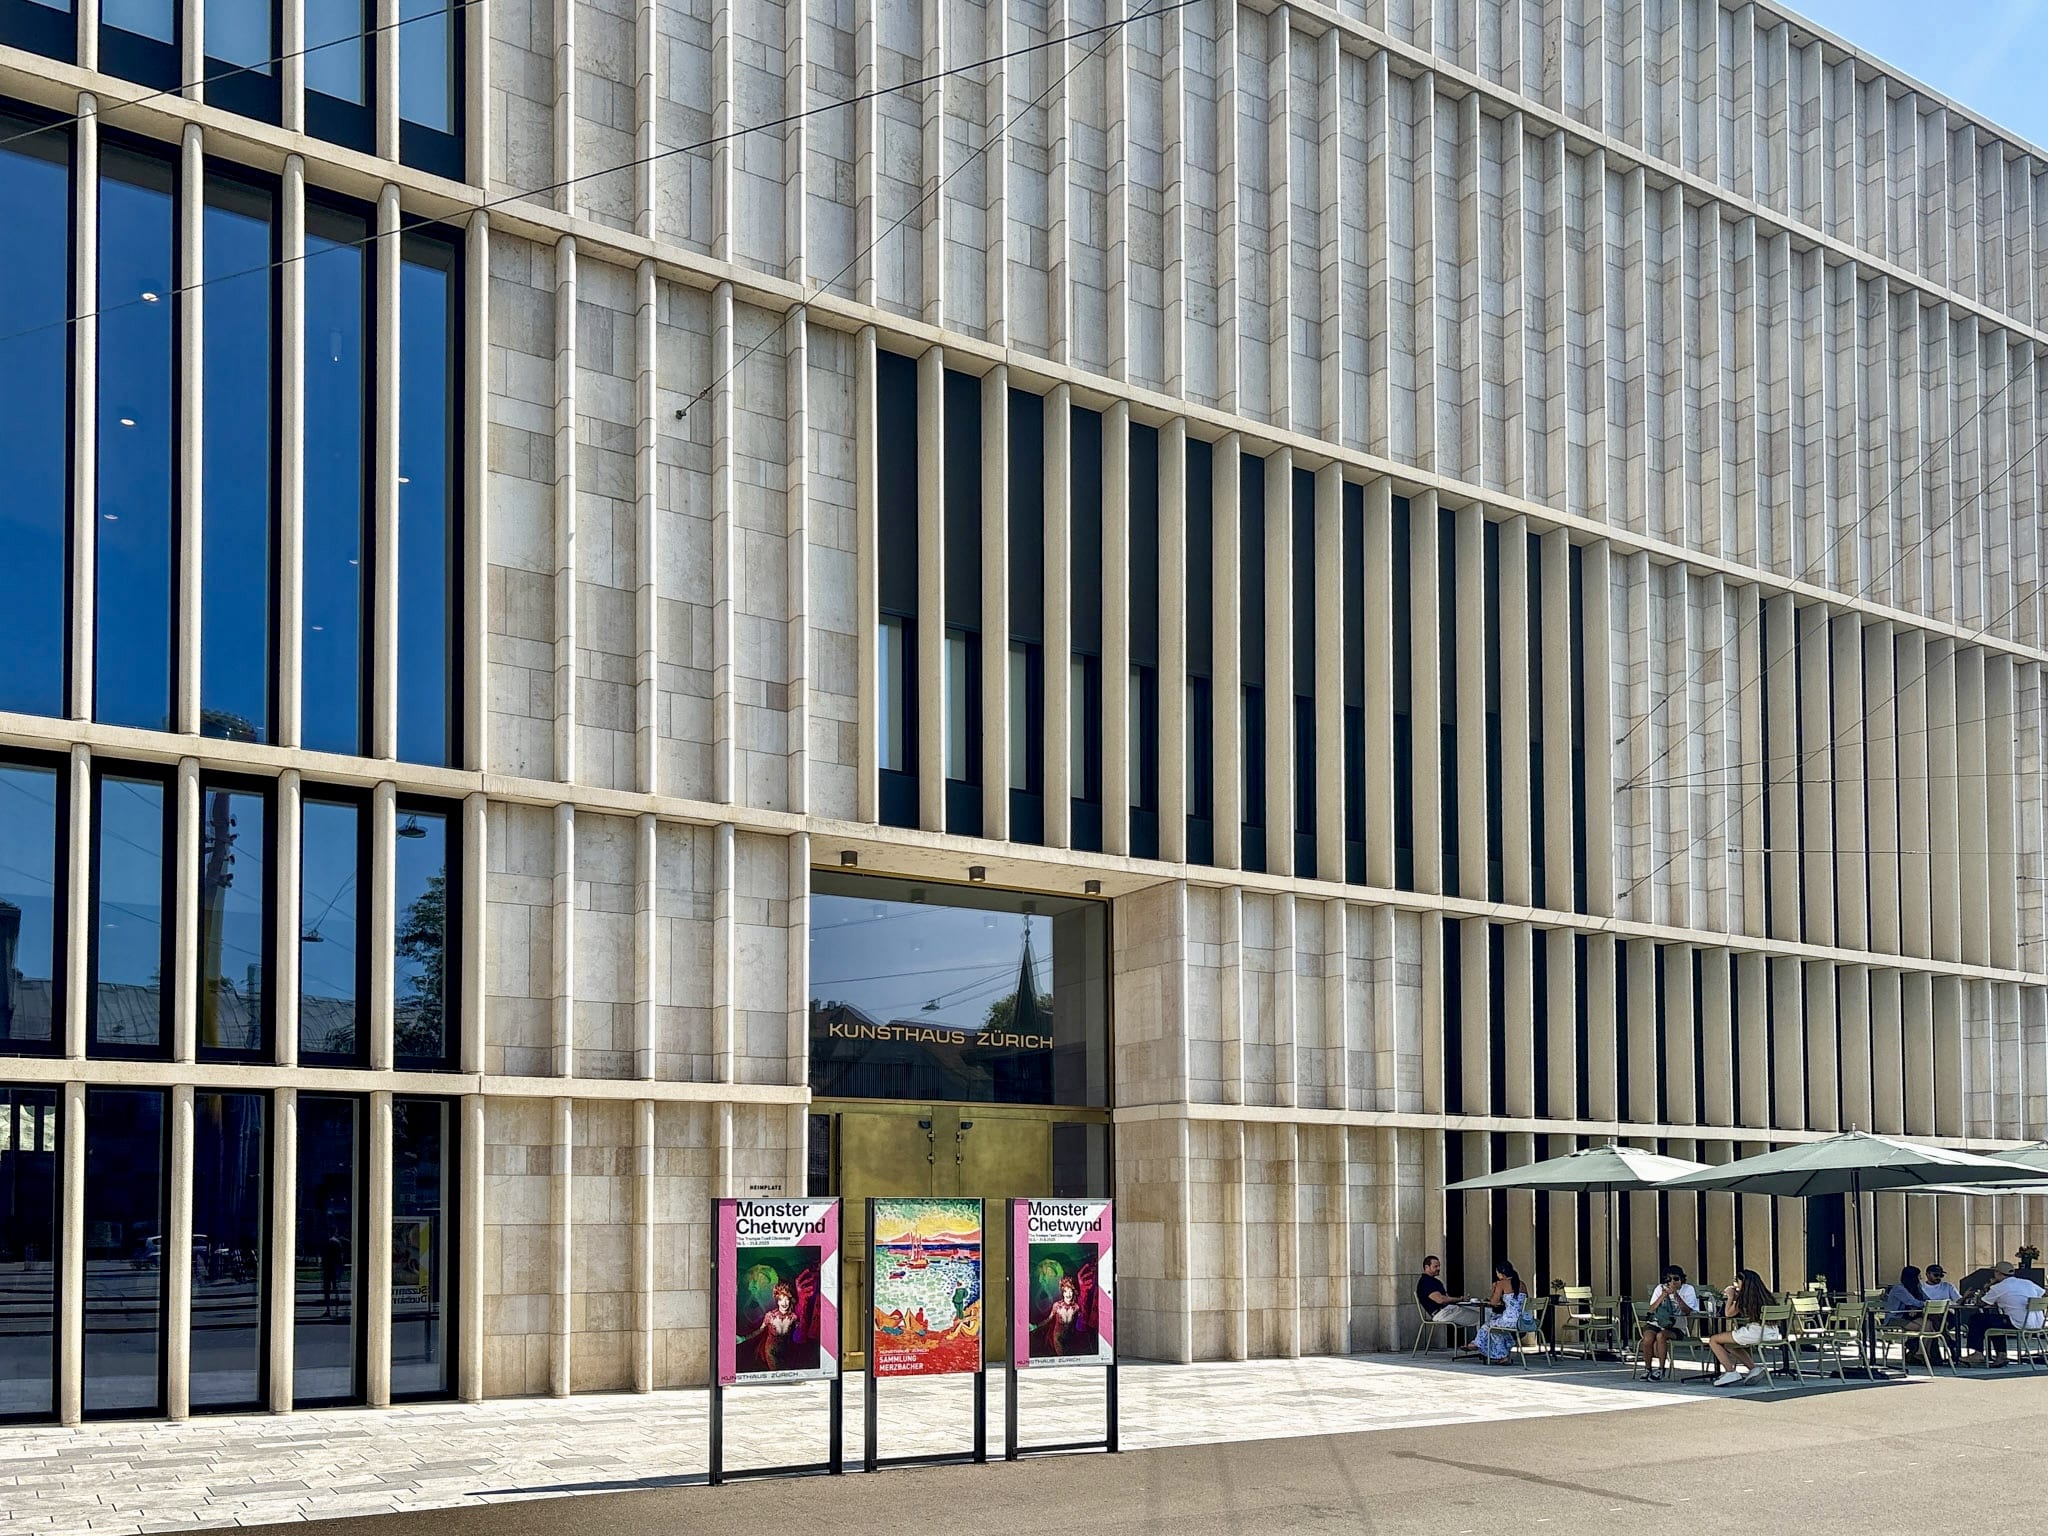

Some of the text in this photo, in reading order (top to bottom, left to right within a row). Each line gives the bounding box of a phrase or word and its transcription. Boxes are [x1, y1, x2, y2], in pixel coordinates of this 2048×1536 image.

[829, 1023, 1054, 1049] KUNSTHAUS ZÜRICH
[736, 1201, 809, 1217] Monster
[1028, 1201, 1088, 1216] Monster
[736, 1217, 826, 1237] Chetwynd
[1028, 1217, 1102, 1235] Chetwynd
[879, 1355, 917, 1364] SAMMLUNG
[879, 1363, 924, 1371] MERZBACHER
[721, 1373, 768, 1381] KUNSTHAUS
